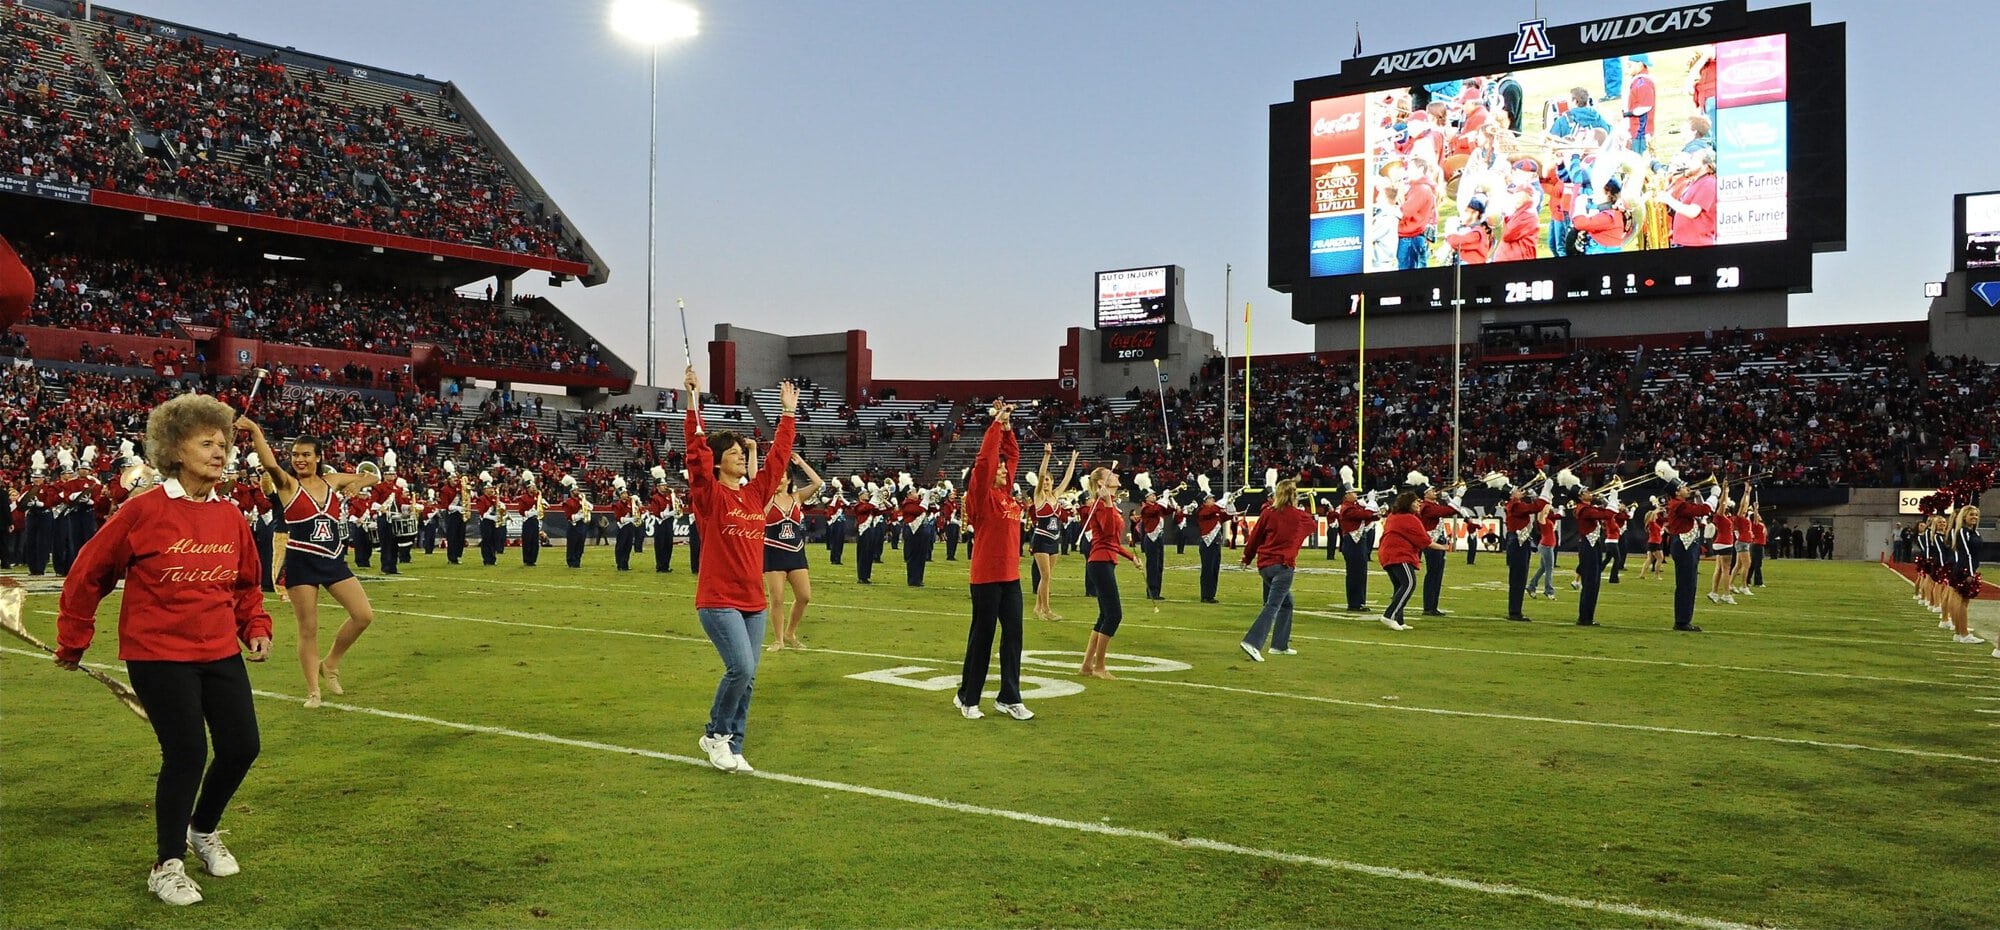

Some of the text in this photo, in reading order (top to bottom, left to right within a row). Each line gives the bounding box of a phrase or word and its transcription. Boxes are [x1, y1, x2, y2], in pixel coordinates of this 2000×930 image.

[1580, 6, 1714, 44] WILDCATS
[1509, 18, 1556, 64] A
[1370, 42, 1476, 76] ARIZONA
[6, 177, 28, 186] Bowl
[1315, 176, 1358, 190] CASINO
[1719, 175, 1785, 191] Jack Furrier
[36, 182, 89, 196] Christmas Classic
[1316, 187, 1359, 201] DEL SOL
[1318, 200, 1356, 212] 11/11/11
[1719, 210, 1785, 225] Jack Furrier
[1101, 273, 1124, 281] AUTO
[1753, 332, 1765, 341] 13
[240, 350, 248, 360] 6
[1118, 348, 1144, 359] zero
[1520, 346, 1530, 355] 12
[404, 364, 409, 373] 7
[310, 519, 334, 541] A
[779, 522, 796, 540] A
[165, 538, 235, 554] Alumni
[160, 565, 239, 582] Twirler
